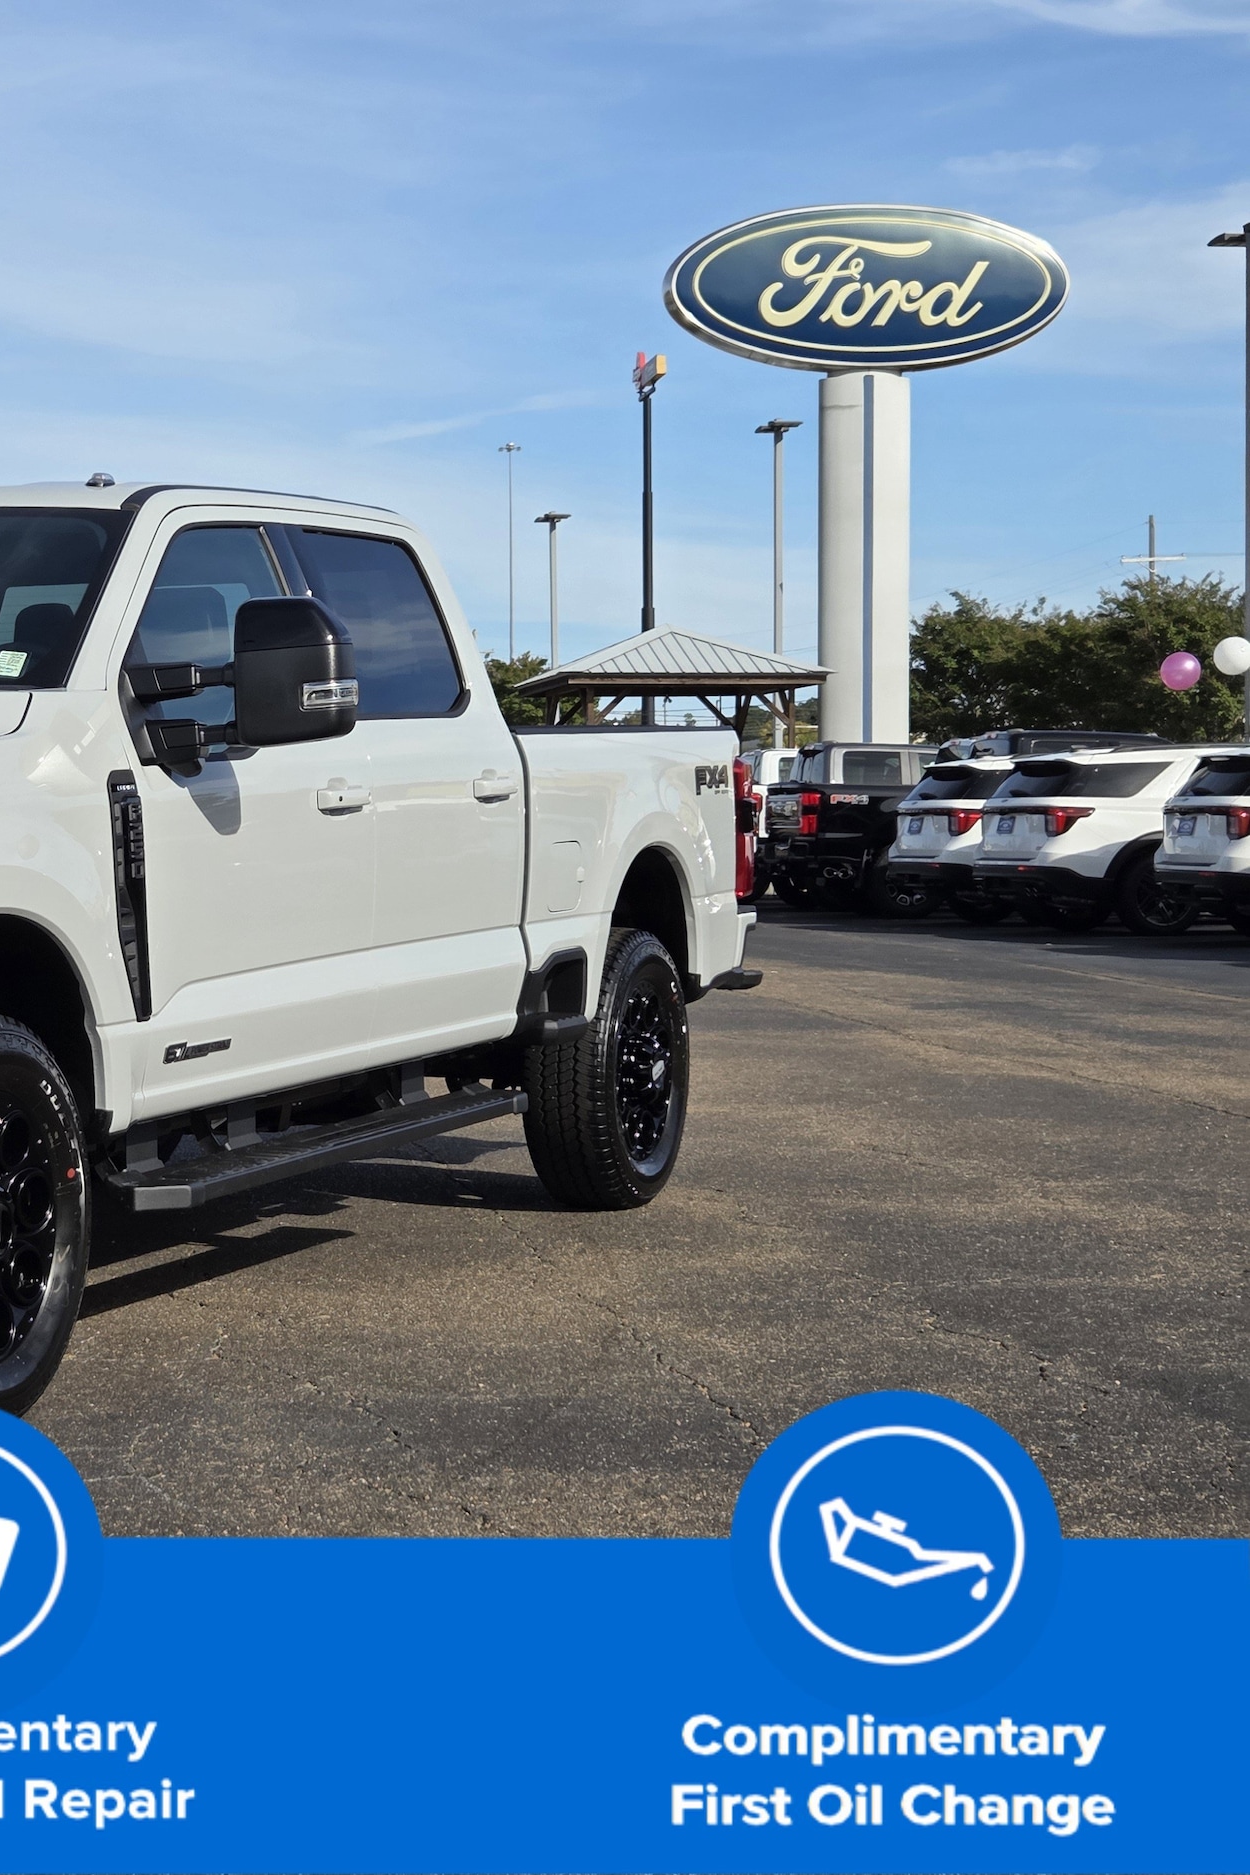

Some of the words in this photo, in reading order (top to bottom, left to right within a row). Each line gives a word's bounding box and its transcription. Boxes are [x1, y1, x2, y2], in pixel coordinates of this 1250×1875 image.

[758, 236, 990, 328] Ford
[694, 764, 729, 796] FX4
[830, 794, 869, 805] FX4
